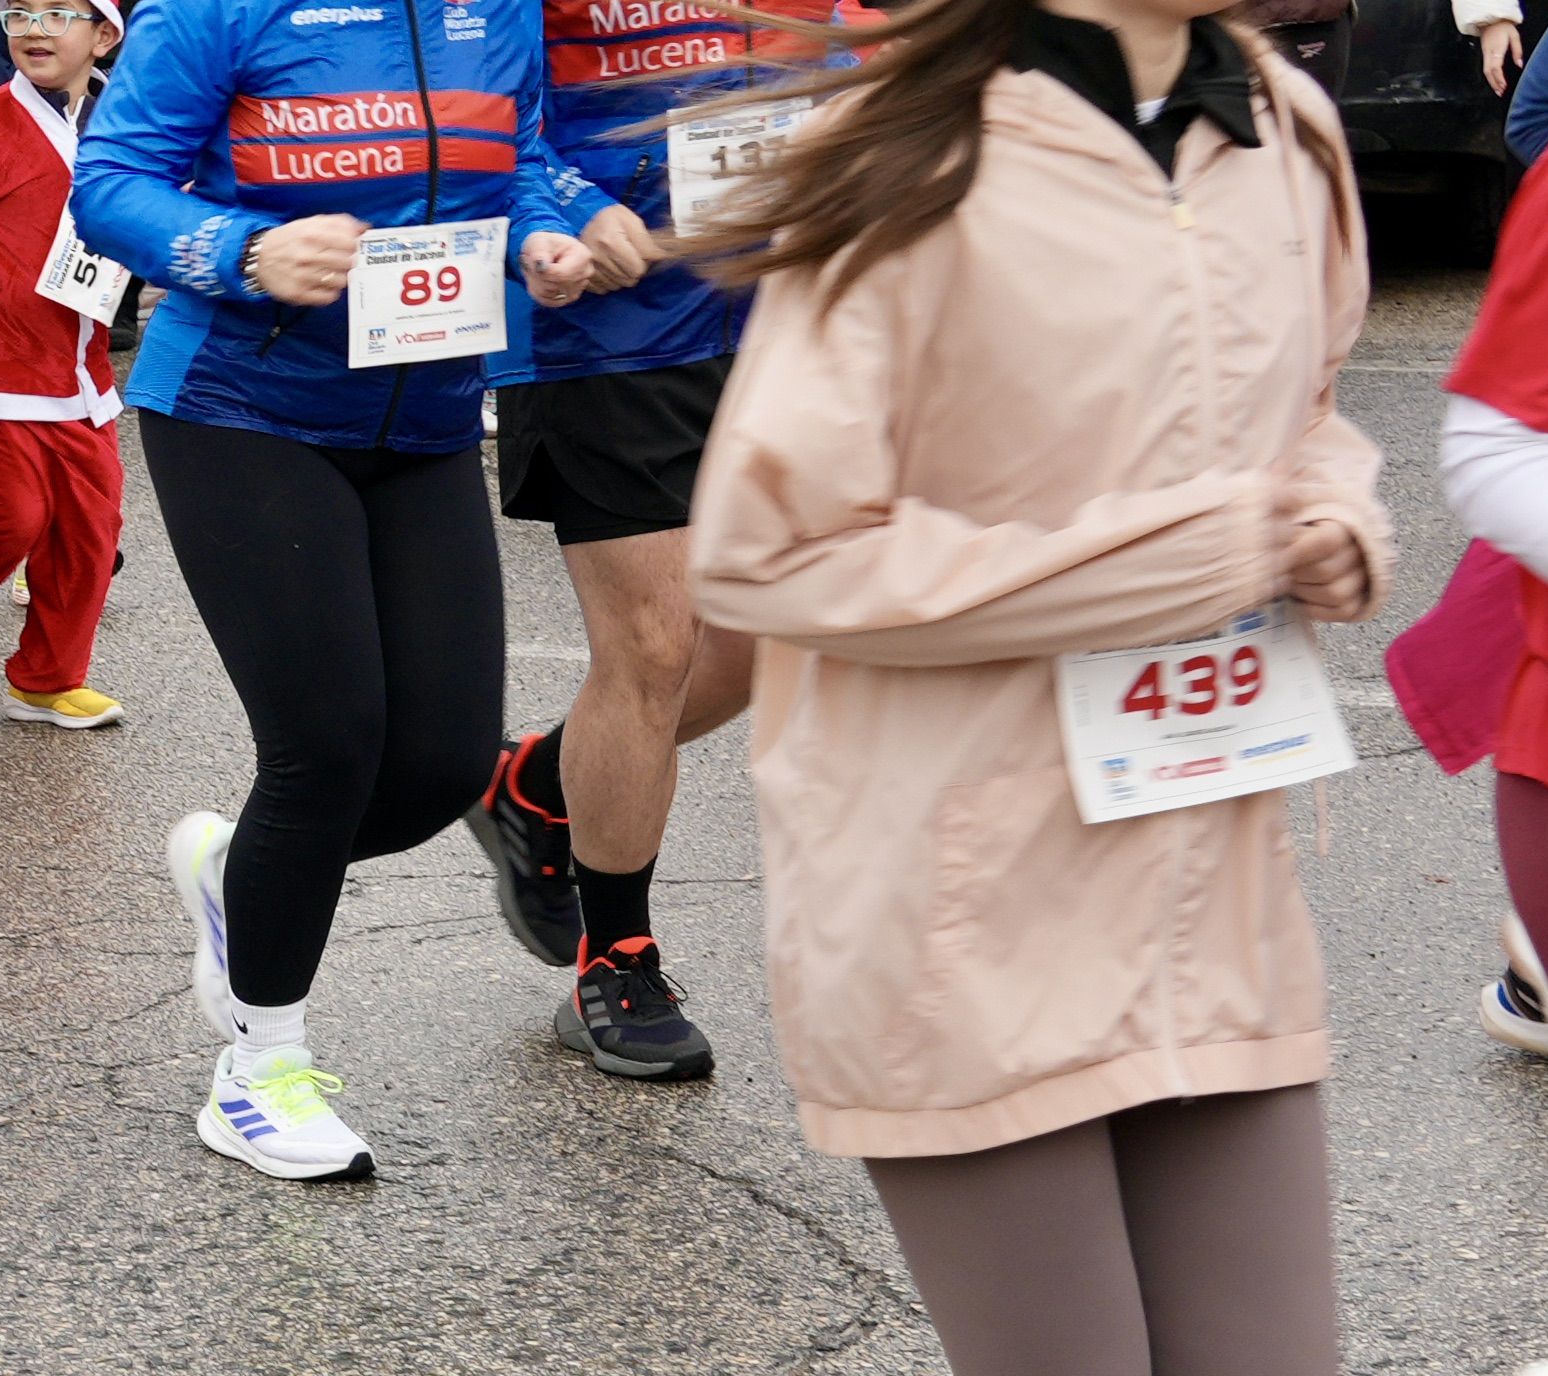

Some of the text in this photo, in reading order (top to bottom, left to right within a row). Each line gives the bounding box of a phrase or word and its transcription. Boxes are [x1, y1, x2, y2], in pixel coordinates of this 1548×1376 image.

[290, 6, 385, 25] enerplus
[596, 36, 727, 78] Lucena
[262, 93, 417, 133] Maratón
[268, 145, 404, 180] Lucena
[401, 266, 461, 306] 89
[1119, 646, 1264, 720] 439
